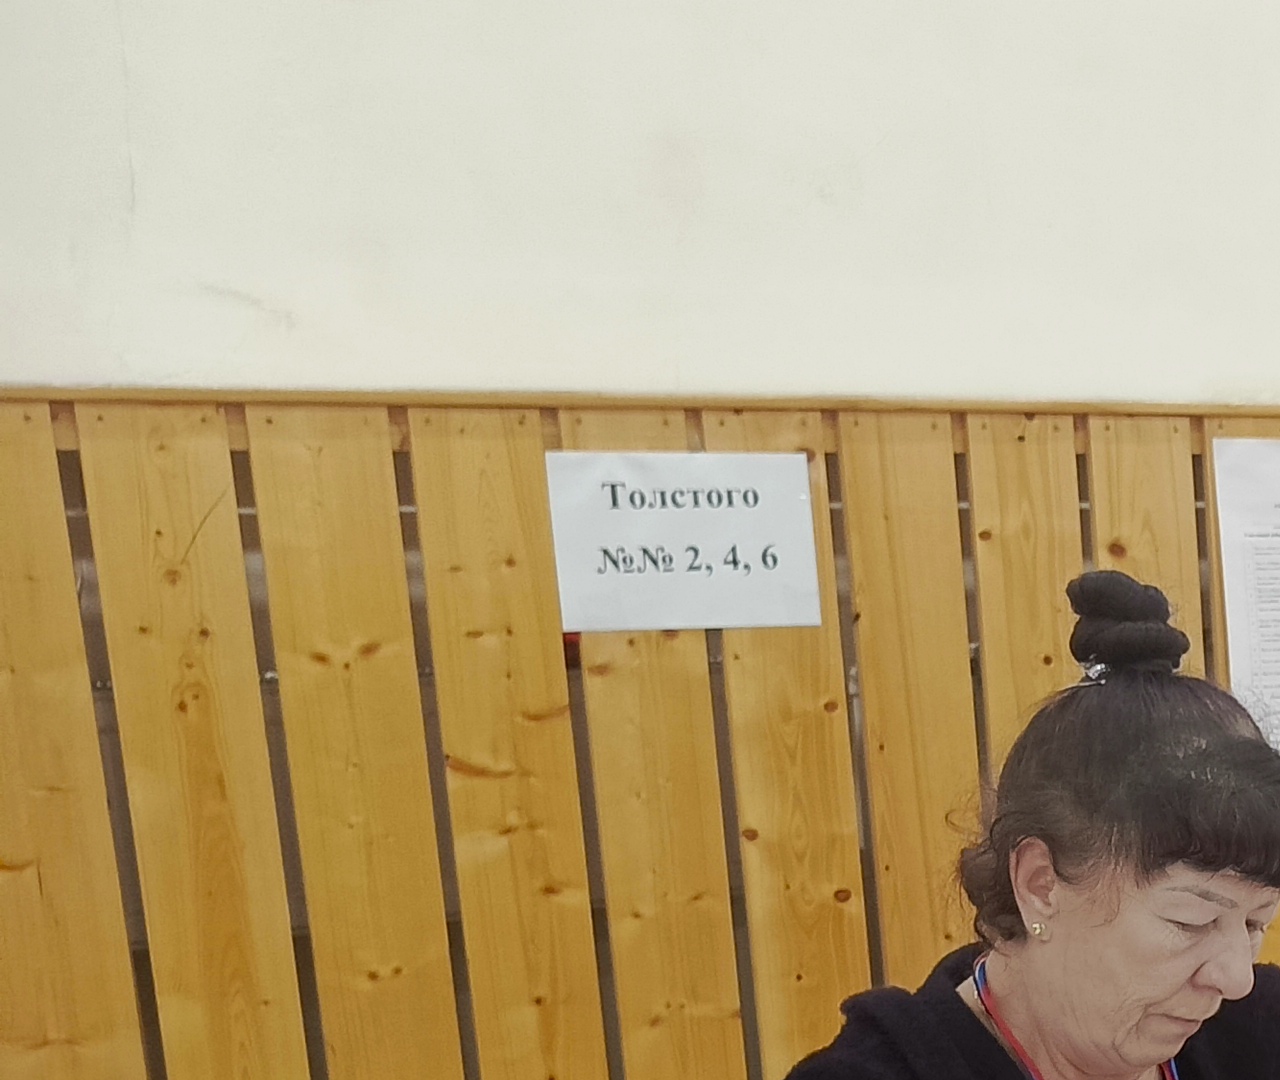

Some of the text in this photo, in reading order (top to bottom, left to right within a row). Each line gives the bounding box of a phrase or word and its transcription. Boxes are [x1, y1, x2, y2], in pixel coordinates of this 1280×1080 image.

[601, 480, 760, 511] Толстого
[684, 545, 714, 576] 2,
[723, 545, 752, 576] 4,
[761, 543, 779, 571] 6
